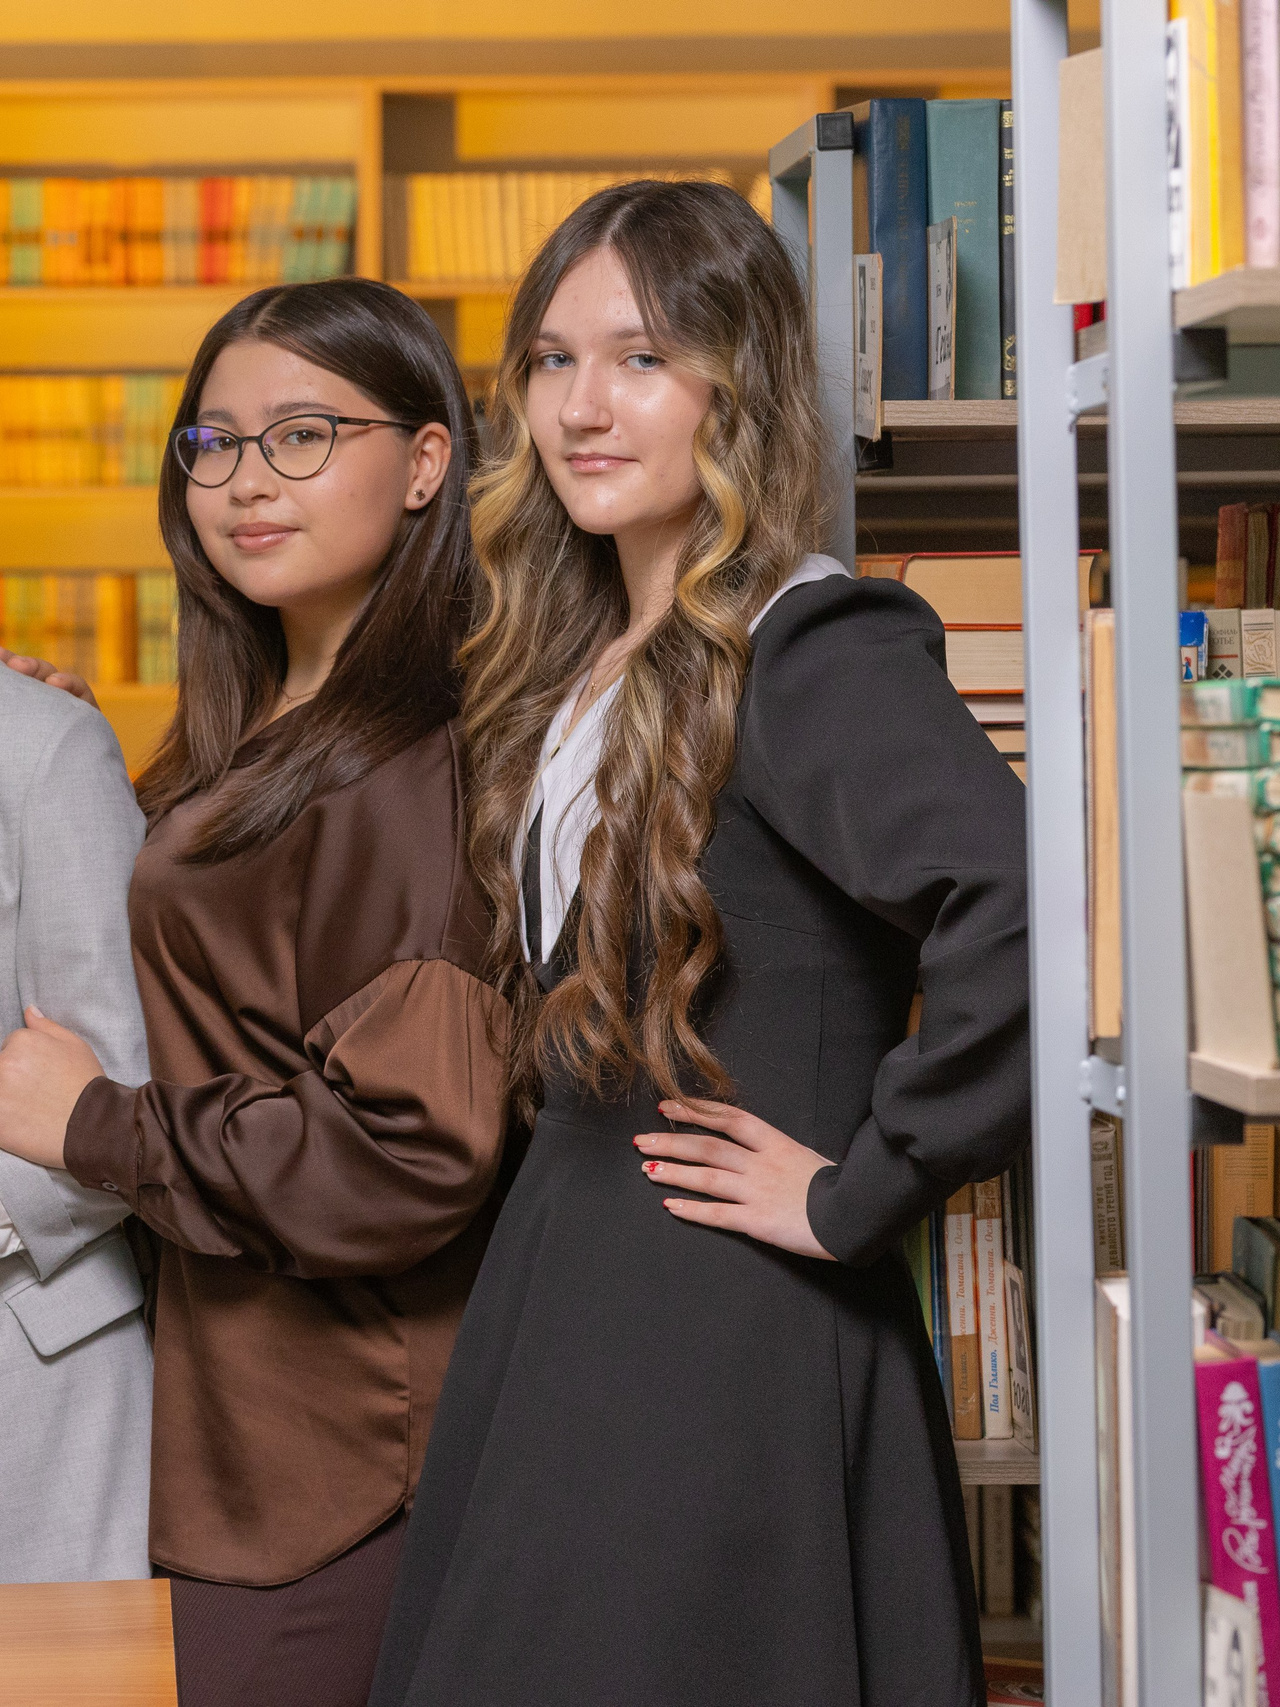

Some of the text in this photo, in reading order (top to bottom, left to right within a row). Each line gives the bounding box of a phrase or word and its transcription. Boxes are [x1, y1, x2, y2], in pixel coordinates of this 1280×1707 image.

[1104, 1164, 1119, 1266] ДЕВЯНОСТО ТРЕТИЙ ГОД
[955, 1251, 965, 1300] Томасина.
[986, 1248, 996, 1296] Томасина.
[987, 1302, 998, 1346] Дженни.
[988, 1350, 998, 1388] Гэллико.
[990, 1394, 999, 1413] Пол
